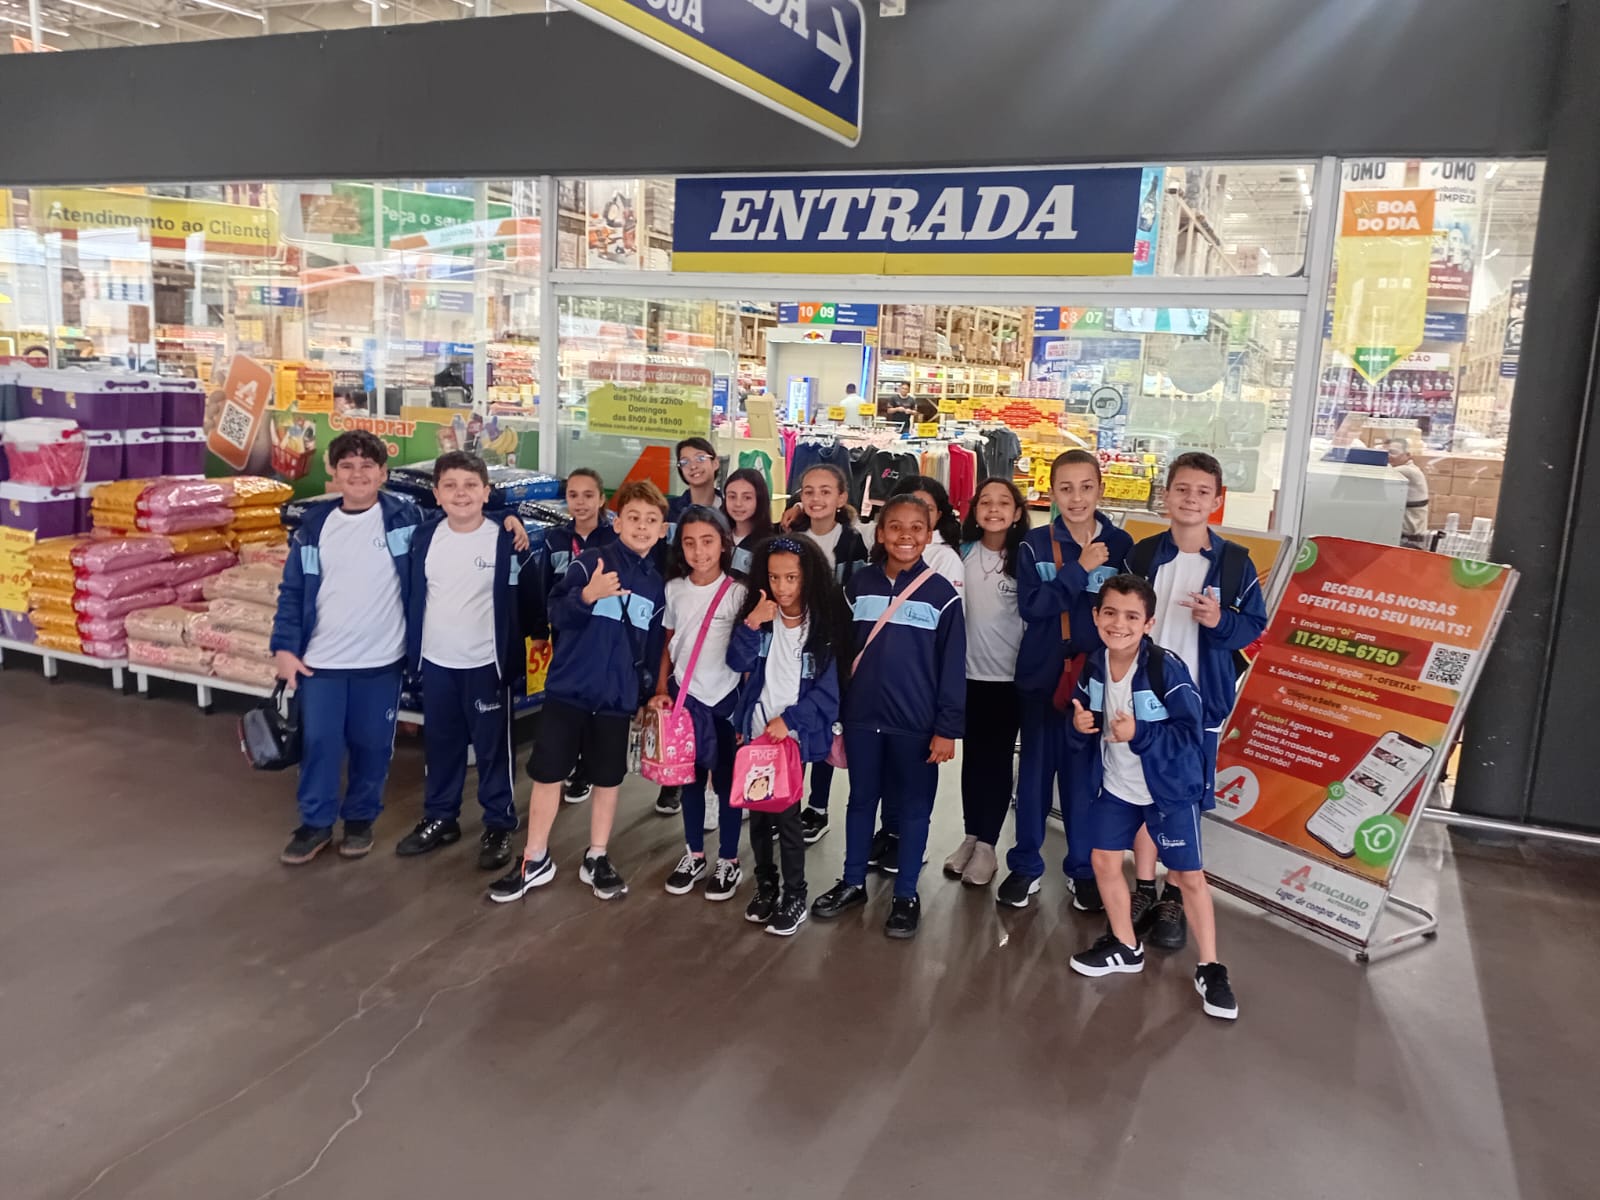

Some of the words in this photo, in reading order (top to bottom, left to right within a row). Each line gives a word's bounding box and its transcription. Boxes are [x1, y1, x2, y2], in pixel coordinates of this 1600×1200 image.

[1351, 162, 1386, 182] OMO
[1442, 161, 1476, 181] OMO
[381, 204, 417, 226] Peça
[420, 213, 431, 225] o
[709, 184, 1078, 243] ENTRADA
[1376, 200, 1417, 214] BOA
[48, 204, 175, 231] Atendimento
[181, 218, 204, 233] ao
[209, 219, 271, 239] Cliente
[1357, 218, 1384, 231] DO
[1386, 216, 1421, 231] DIA
[800, 305, 814, 317] 10
[820, 306, 835, 318] 09
[1060, 311, 1078, 323] 08
[1085, 311, 1103, 324] 07
[628, 404, 667, 415] Domingos
[328, 411, 417, 438] Comprar
[1321, 581, 1373, 601] RECEBA
[1374, 592, 1396, 605] AS
[1395, 595, 1457, 616] NOSSAS
[1297, 593, 1358, 613] OFERTAS
[1356, 605, 1380, 618] NO
[1380, 609, 1409, 624] SEU
[1409, 615, 1473, 637] WHATS!
[1321, 624, 1335, 633] um
[1354, 632, 1376, 643] para
[1295, 630, 1308, 645] 11
[1308, 634, 1400, 666] 2795-6750
[1299, 656, 1329, 670] Escolha
[1277, 667, 1314, 684] Selecione
[1320, 678, 1337, 690] loja
[1294, 699, 1309, 712] loja
[1348, 705, 1382, 720] número
[1255, 720, 1289, 736] receberá
[1289, 731, 1300, 740] as
[1258, 711, 1289, 725] Pronto!
[1289, 720, 1313, 733] Agora
[1313, 728, 1334, 739] você
[1247, 738, 1284, 755] Atacadão
[1284, 751, 1296, 760] na
[1295, 754, 1323, 768] palma
[1251, 729, 1279, 743] Ofertas
[1279, 738, 1328, 759] Arrasadoras
[1328, 753, 1341, 763] do
[1243, 747, 1254, 756] da
[1254, 751, 1269, 761] sua
[1269, 755, 1292, 768] mão!
[1309, 880, 1369, 910] ATACADÃO
[1274, 887, 1296, 901] Lugar
[1295, 896, 1306, 906] de
[1305, 901, 1337, 918] comprar
[1335, 912, 1361, 930] barato
